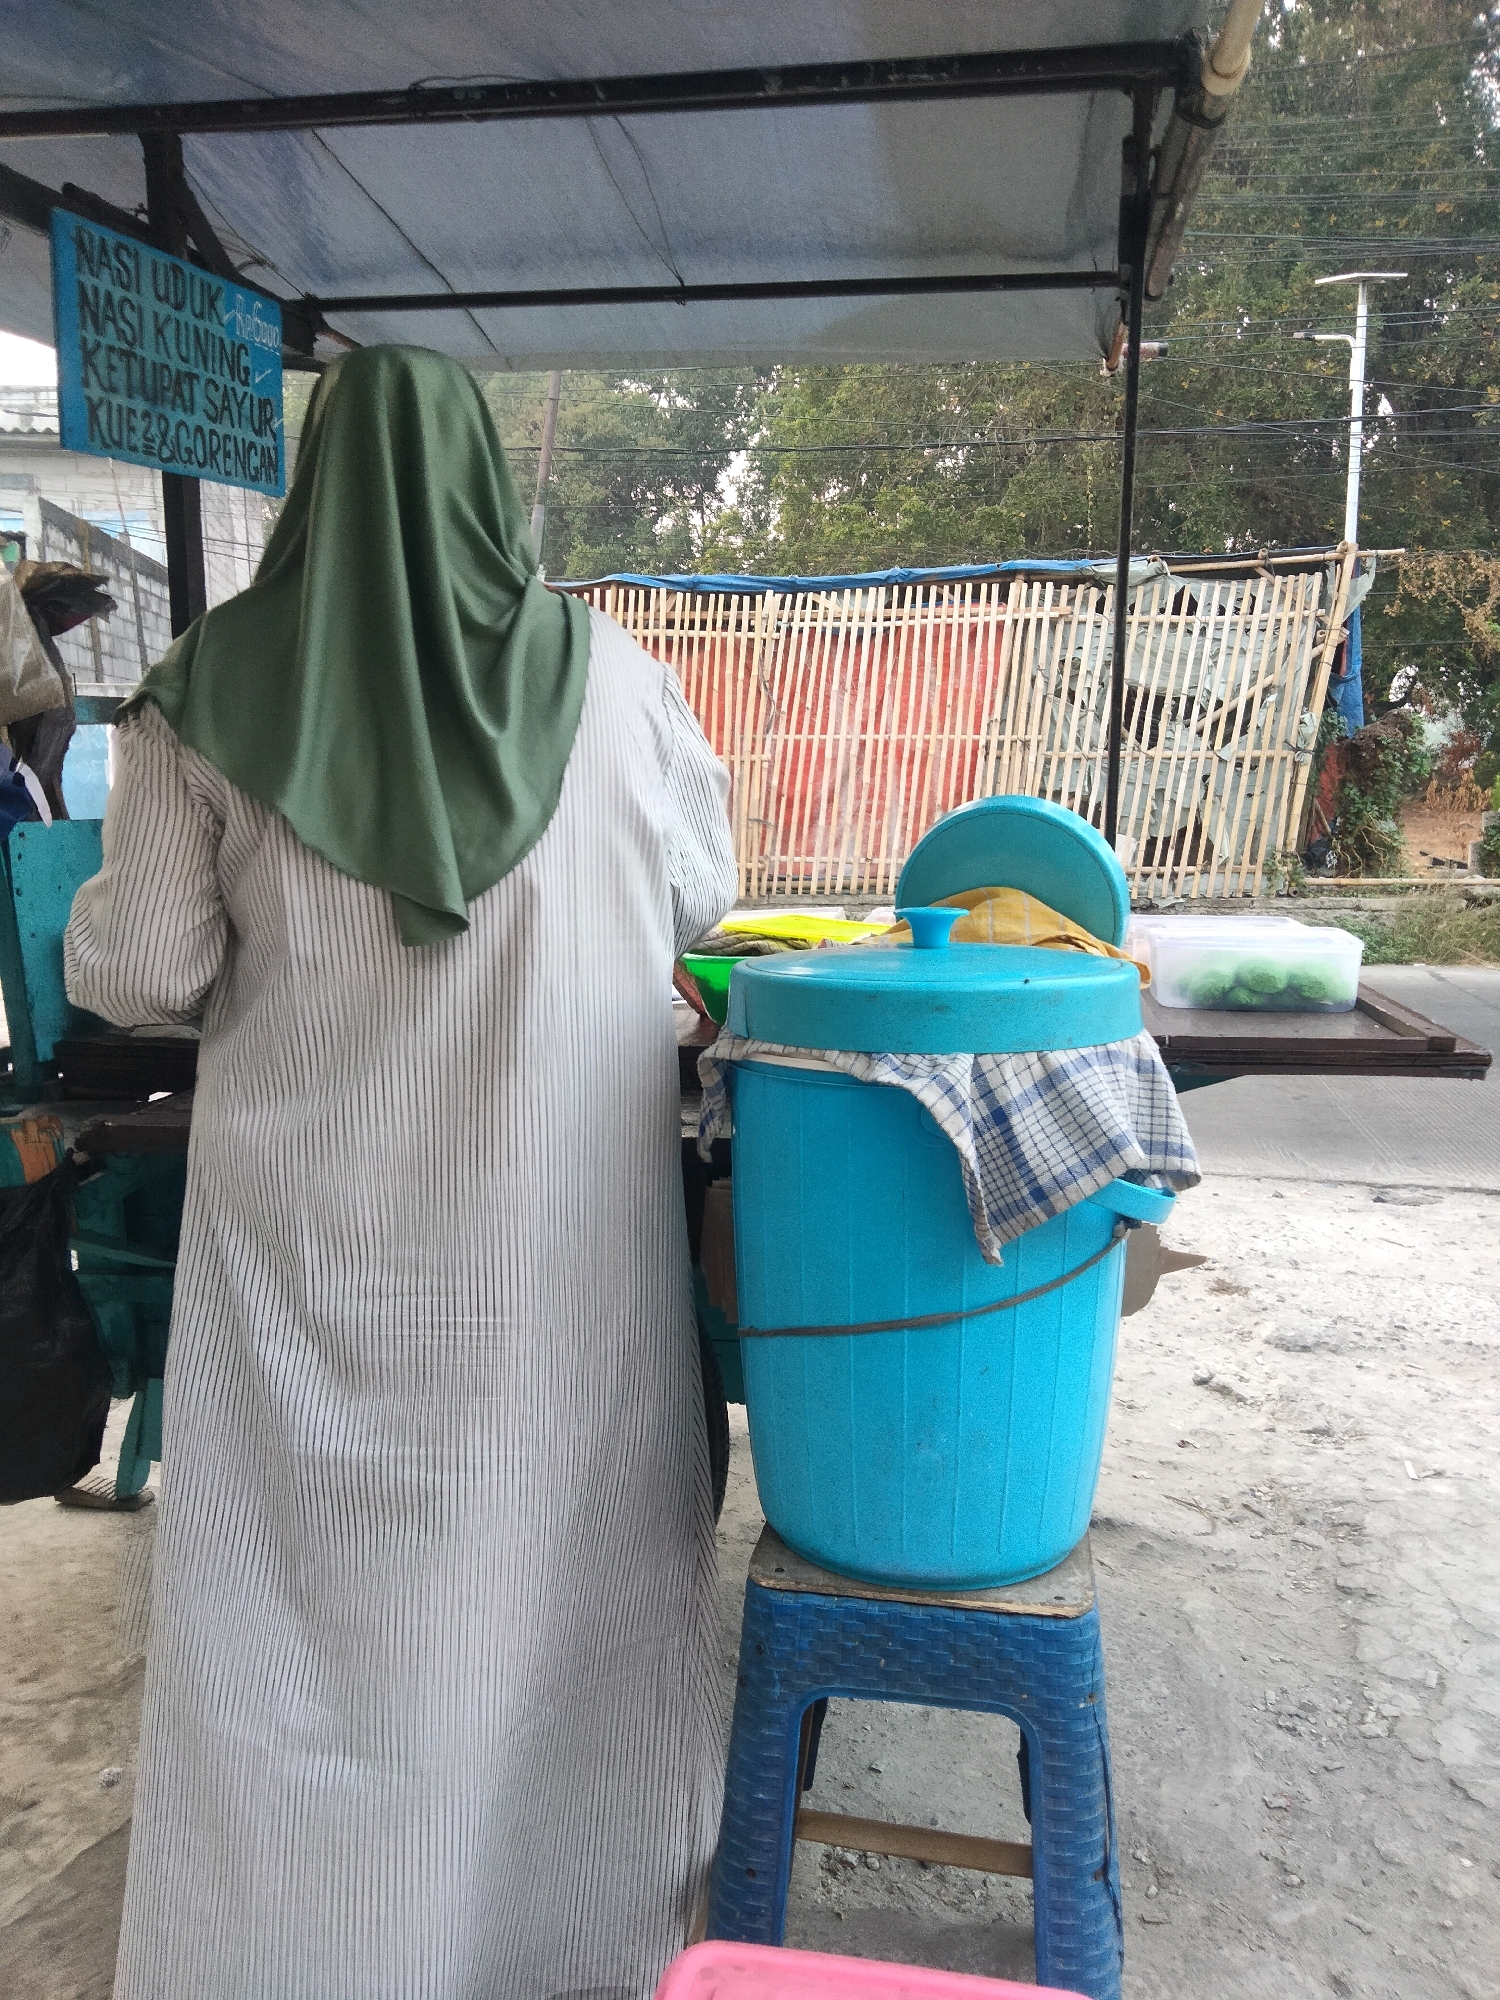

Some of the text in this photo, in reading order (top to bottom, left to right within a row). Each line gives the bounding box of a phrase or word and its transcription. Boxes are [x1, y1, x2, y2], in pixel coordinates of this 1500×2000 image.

[72, 225, 224, 327] NASI UDUK
[78, 280, 251, 388] NASI KUNING
[80, 335, 277, 443] KETUPAT SAYUR
[174, 420, 279, 486] GORENGAN
